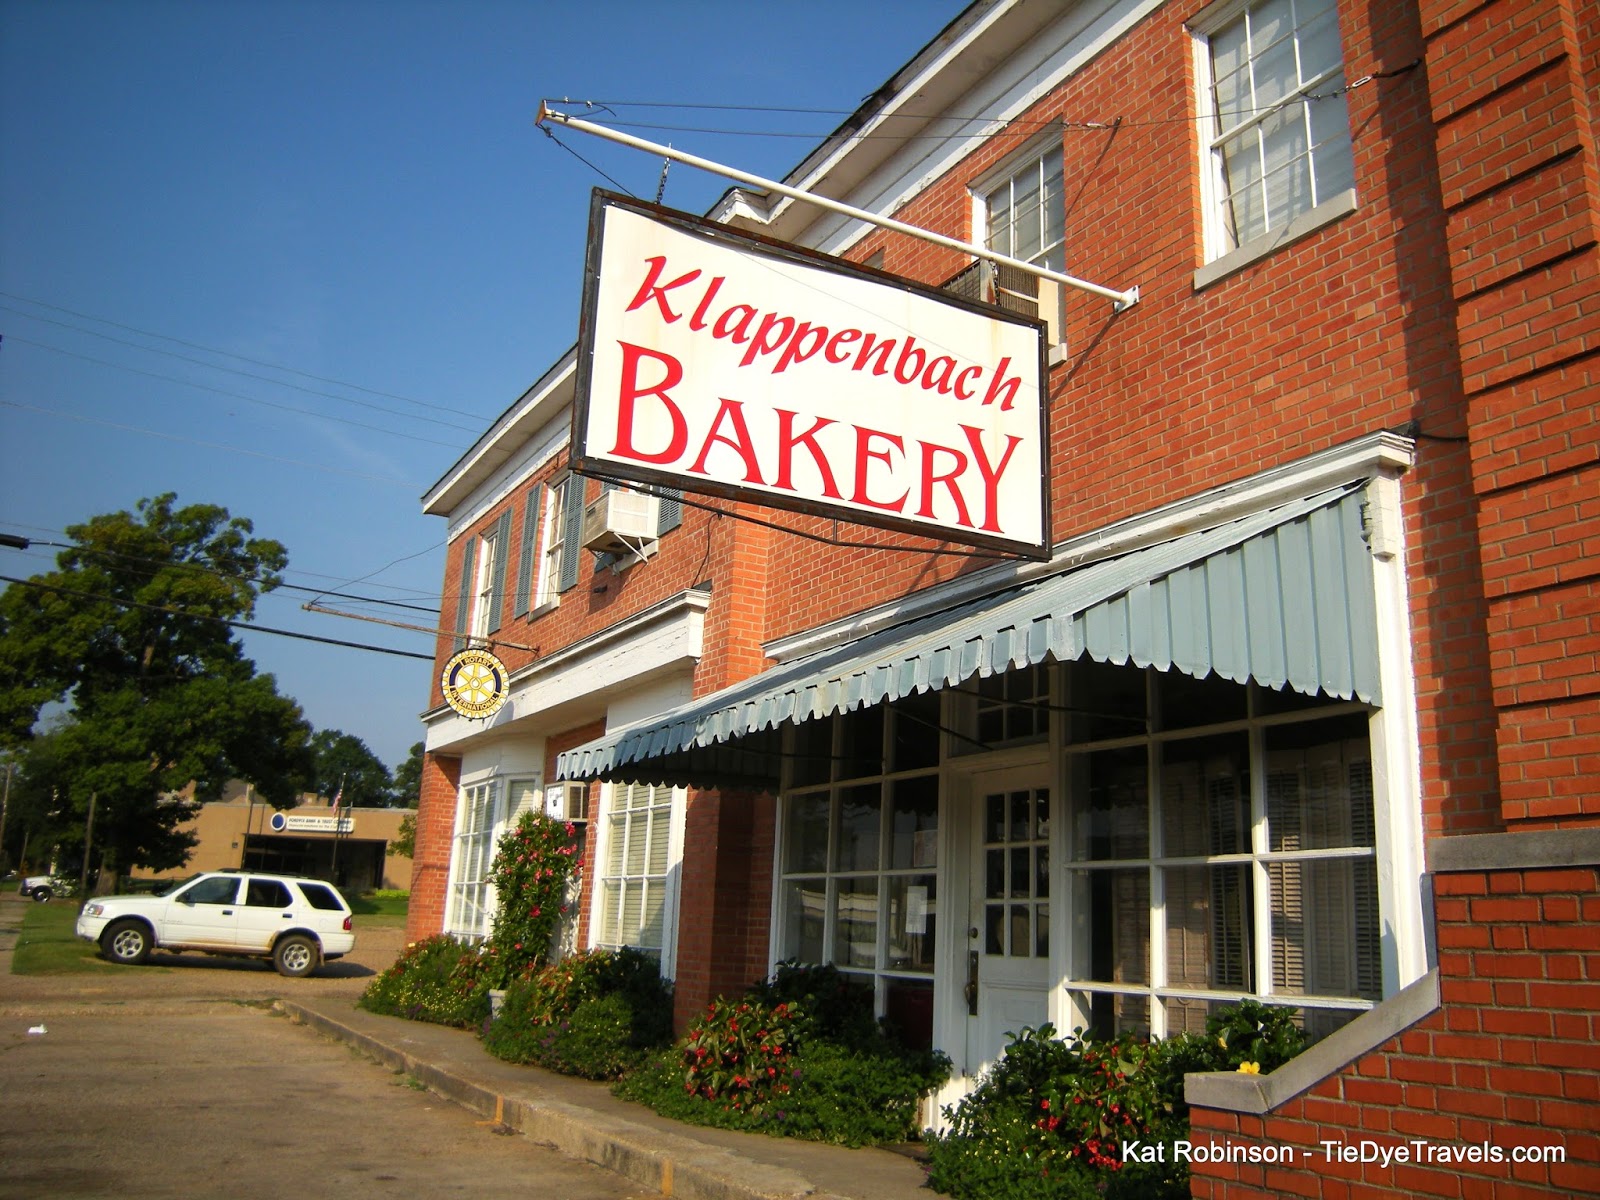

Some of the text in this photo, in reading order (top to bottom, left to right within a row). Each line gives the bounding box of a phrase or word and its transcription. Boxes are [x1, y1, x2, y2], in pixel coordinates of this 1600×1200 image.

[625, 255, 1022, 412] Klappenbach
[606, 340, 1024, 534] BAKERY
[451, 690, 498, 711] INTERNATIONAL
[464, 656, 492, 667] ROTARY
